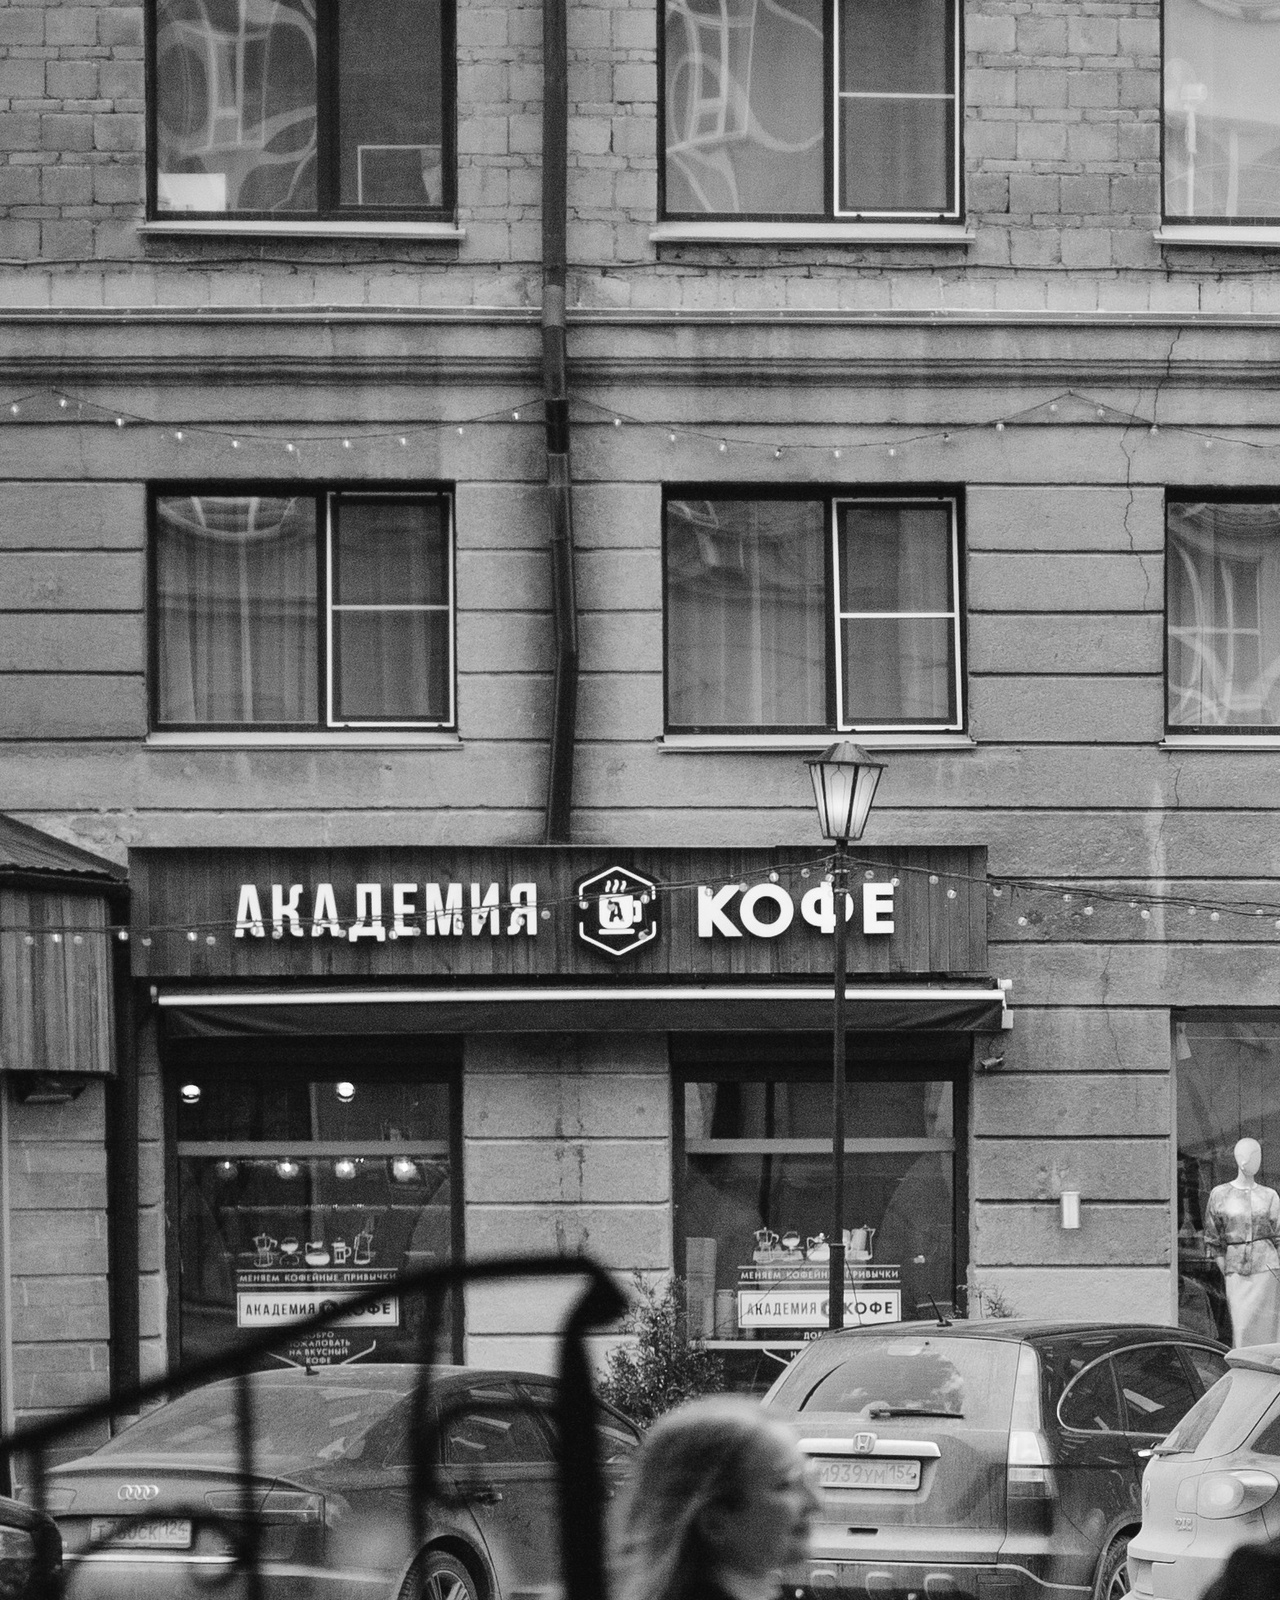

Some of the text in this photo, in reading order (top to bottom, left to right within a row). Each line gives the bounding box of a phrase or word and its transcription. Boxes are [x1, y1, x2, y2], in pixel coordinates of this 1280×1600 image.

[234, 881, 896, 942] АКАДЕМИЯ КОФЕ
[239, 1271, 397, 1283] МЕНЯЕМ КОФЕЙНЫЕ ПРИВЫЧКИ
[740, 1270, 781, 1280] МЕНЯЕМ
[786, 1269, 831, 1279] КОФЕЙН
[245, 1302, 316, 1316] АКАДЕМИЯ
[747, 1301, 893, 1316] АКАДЕМИЯ КОФЕ
[288, 1346, 349, 1357] НА ВКУСНЫЙ
[305, 1356, 332, 1365] КОФЕ
